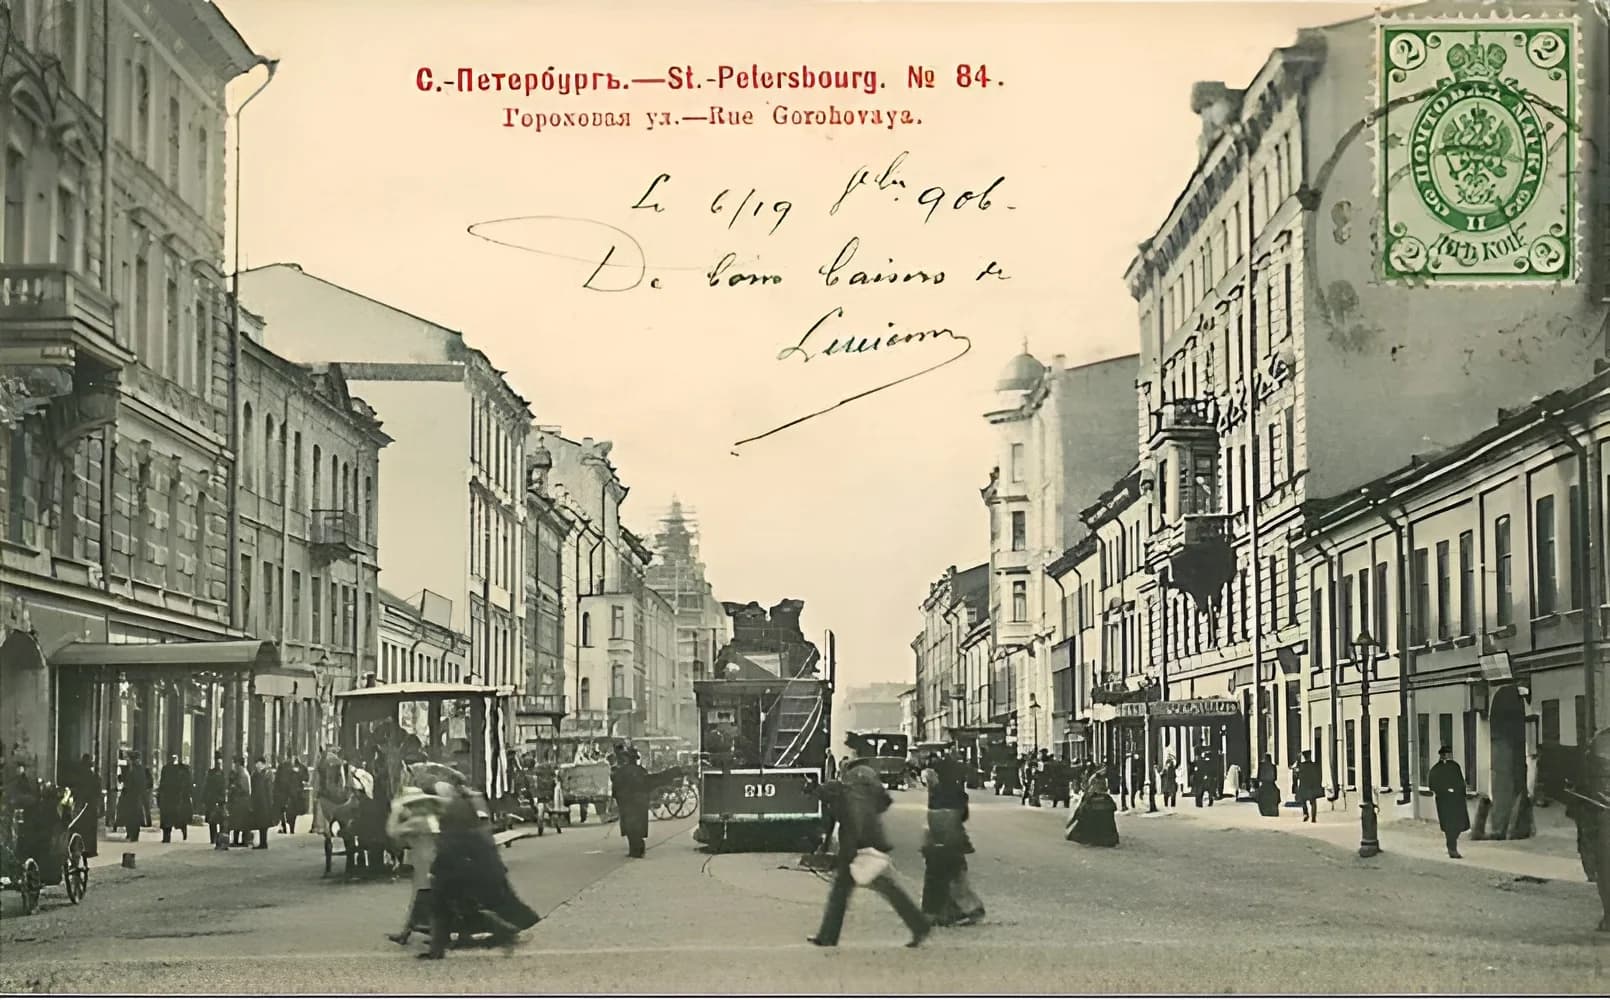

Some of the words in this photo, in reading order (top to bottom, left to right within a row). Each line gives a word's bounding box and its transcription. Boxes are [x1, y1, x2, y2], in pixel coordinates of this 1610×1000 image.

[1398, 38, 1421, 64] 2
[1533, 37, 1559, 61] 2
[710, 188, 793, 236] 6/19
